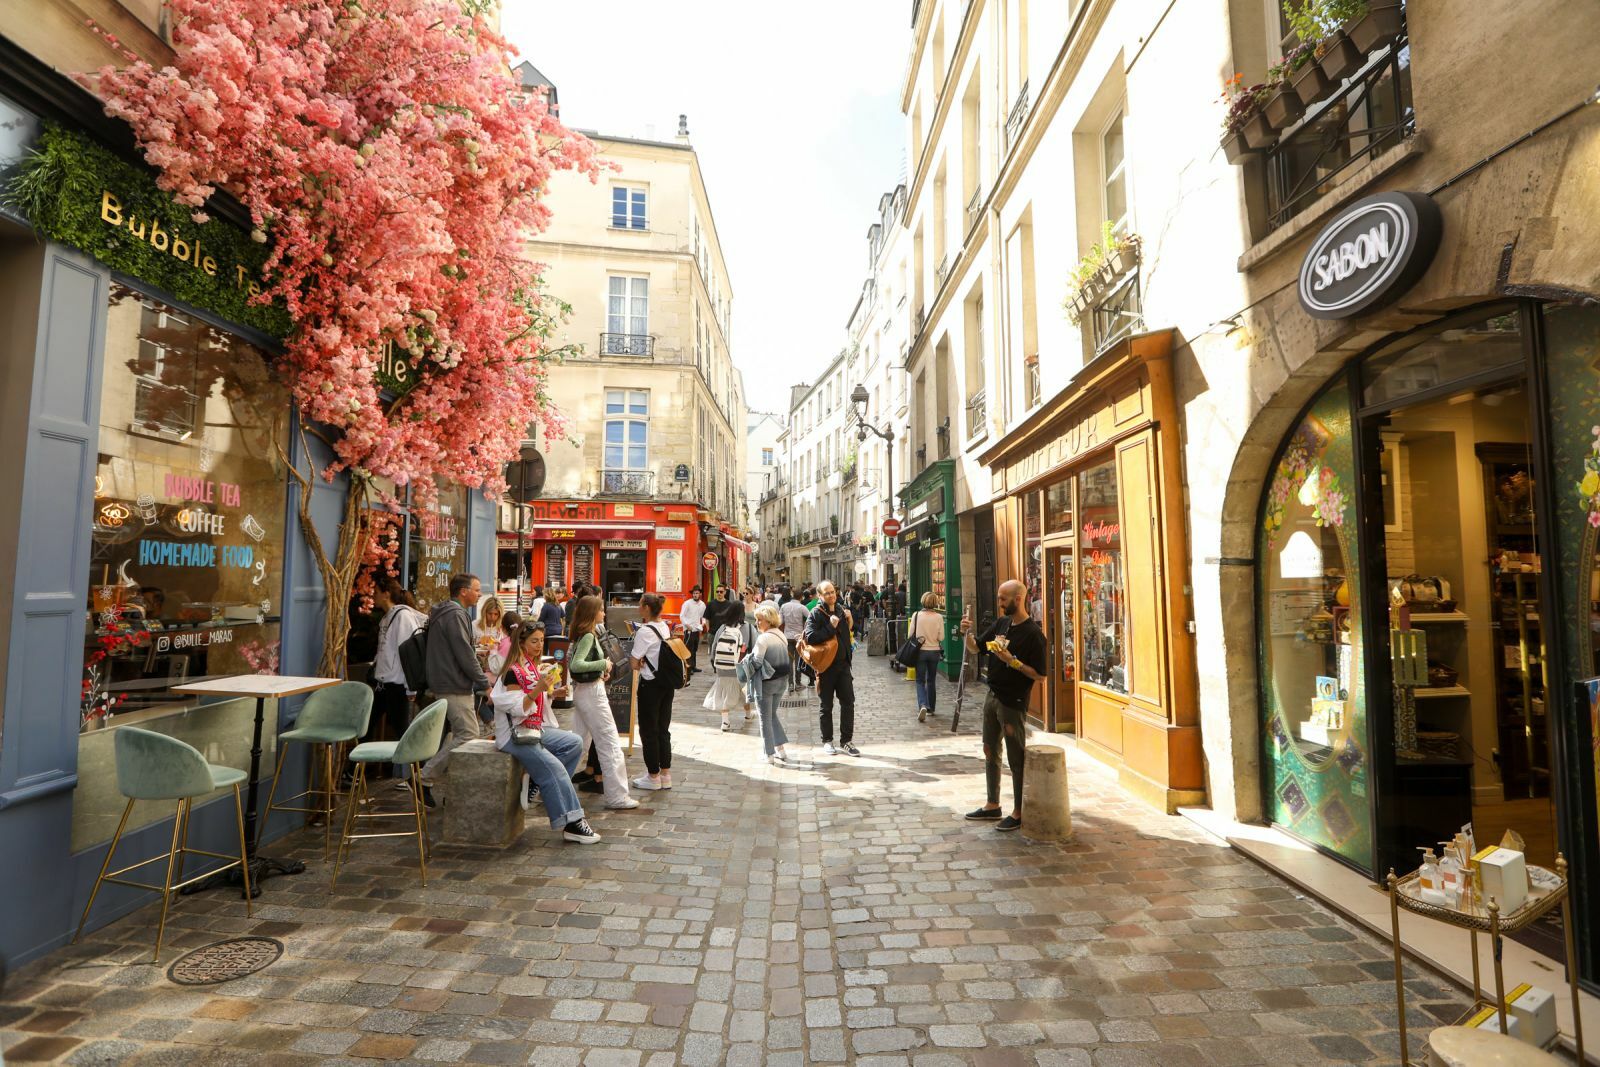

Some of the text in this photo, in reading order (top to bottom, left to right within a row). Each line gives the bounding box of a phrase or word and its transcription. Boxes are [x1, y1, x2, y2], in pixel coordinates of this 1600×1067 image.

[101, 190, 261, 297] Bubble Te
[1314, 222, 1389, 291] SABON
[164, 473, 241, 507] BUBBLE TEA
[179, 511, 225, 536] COFFEE
[1084, 520, 1120, 543] Vintage
[138, 540, 254, 569] HOMEMADE FOOD
[173, 630, 233, 650] @BULLE_MARAIS
